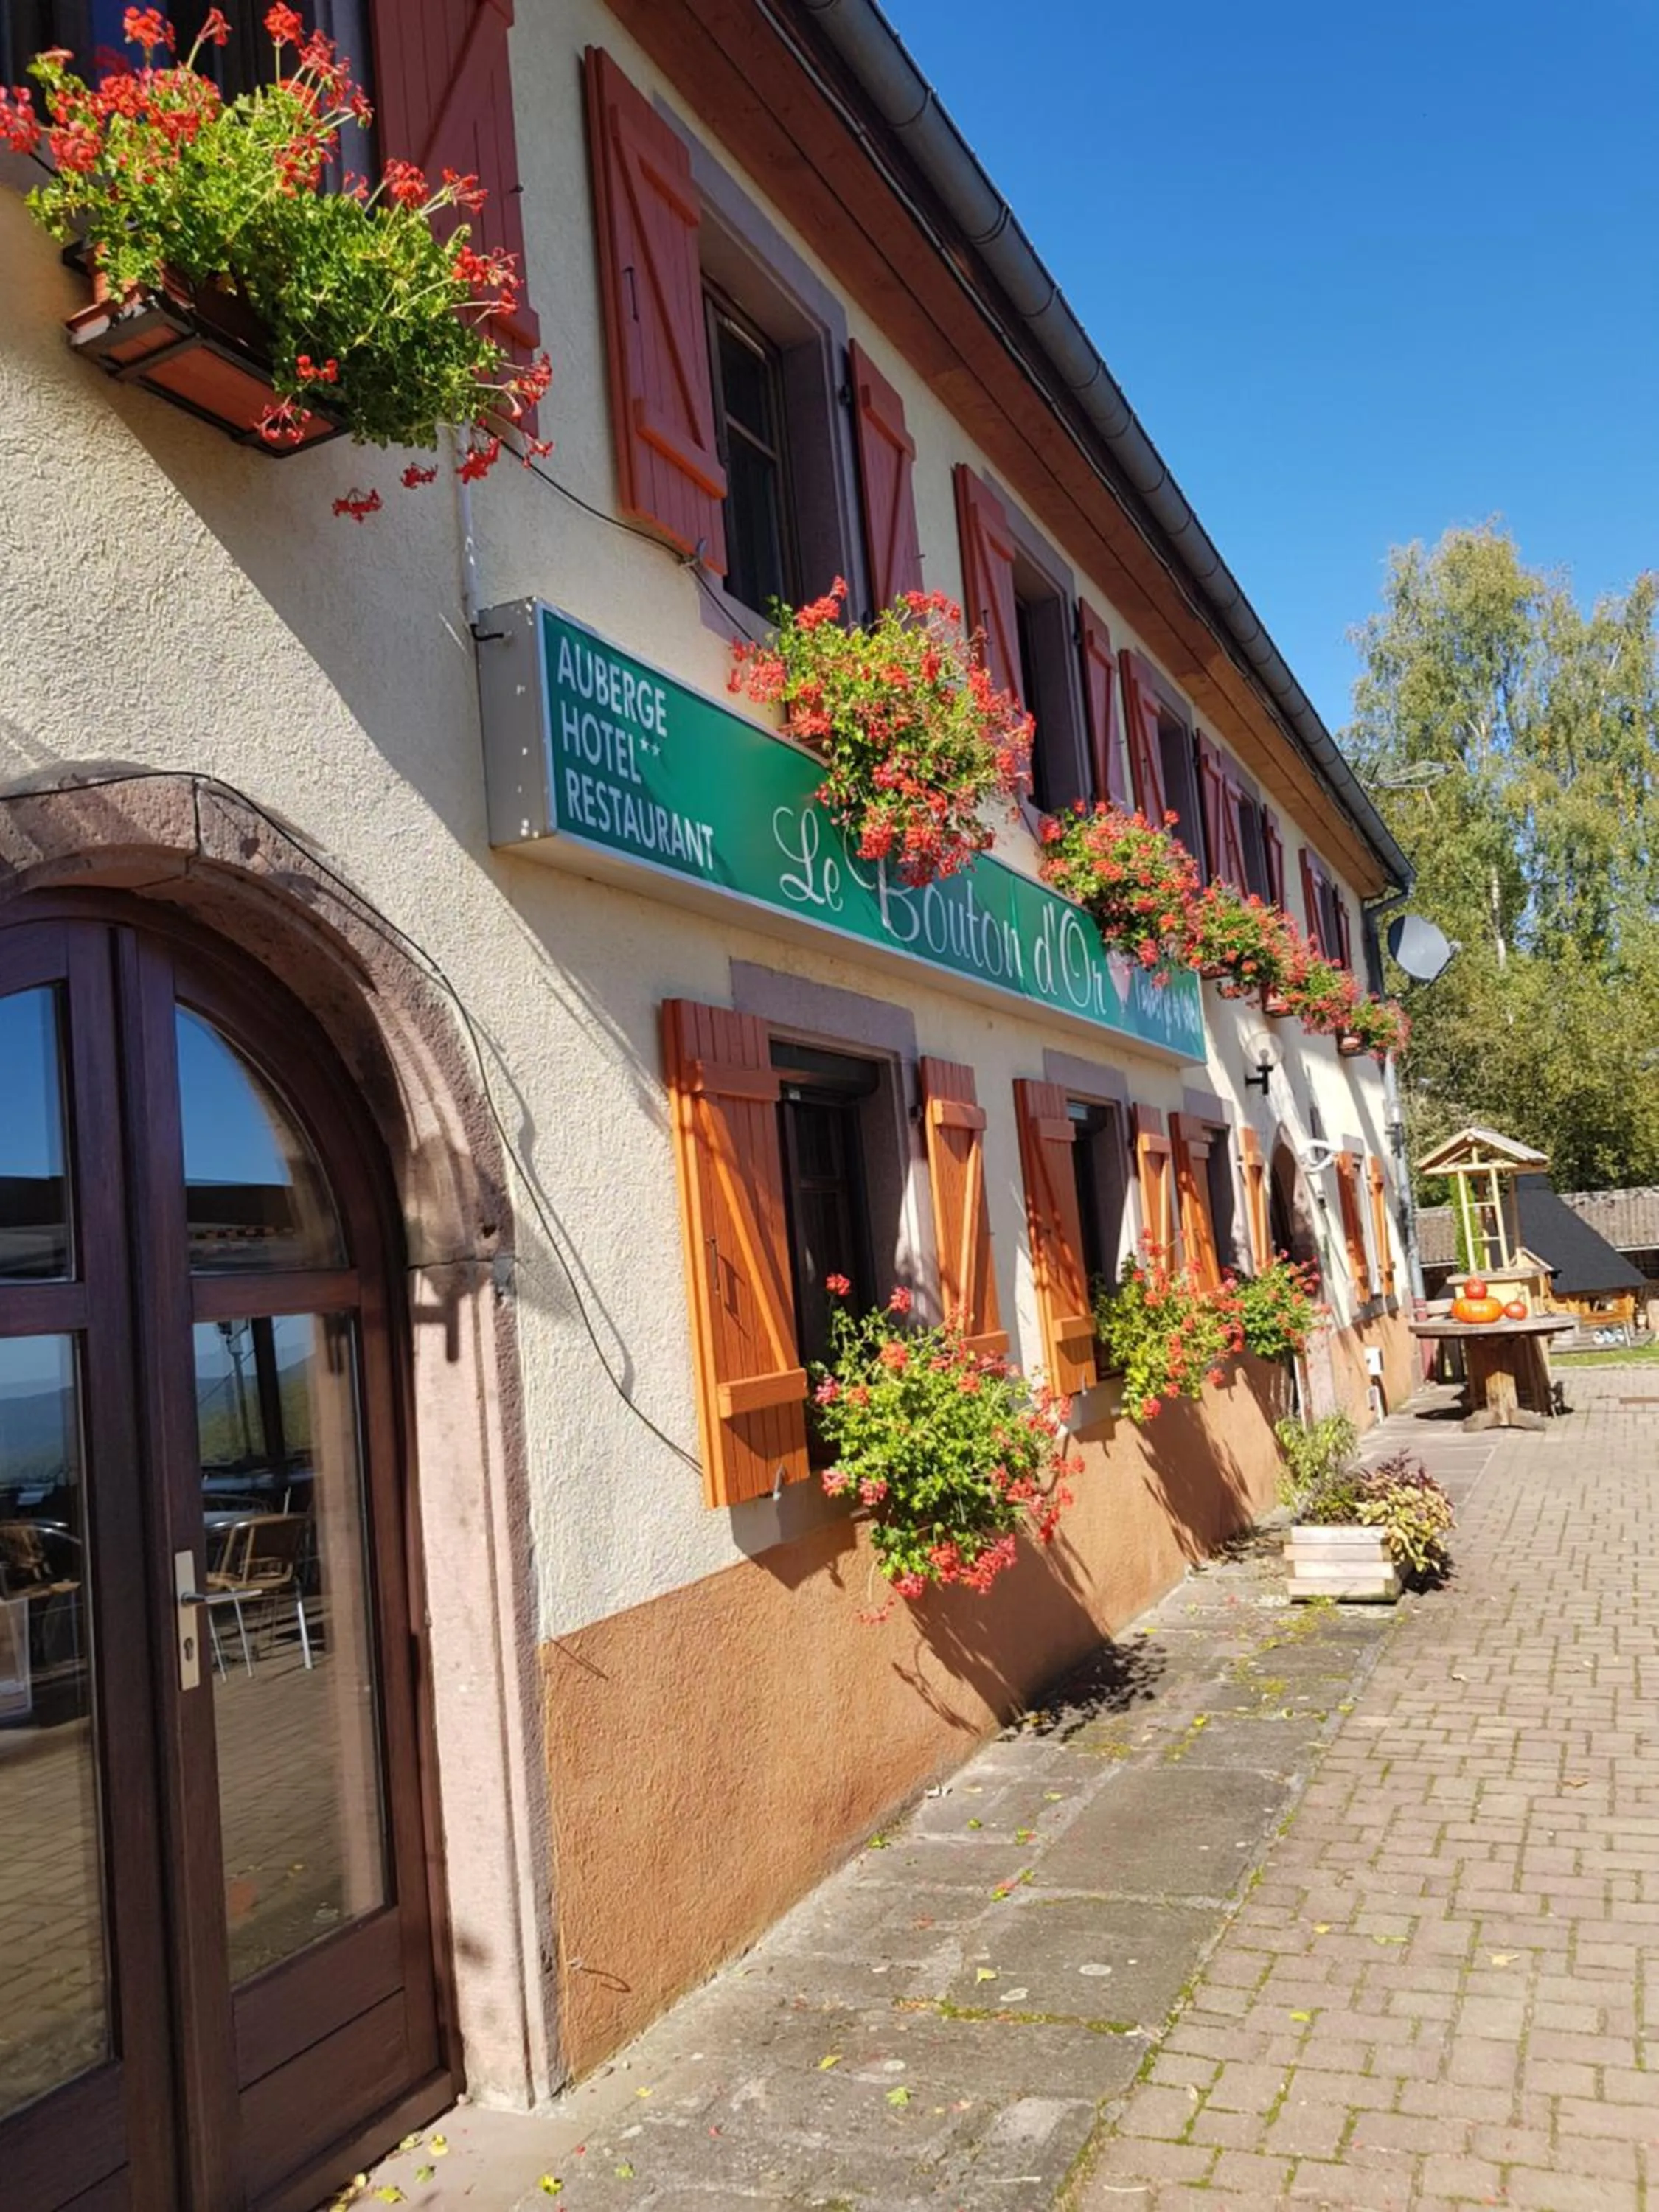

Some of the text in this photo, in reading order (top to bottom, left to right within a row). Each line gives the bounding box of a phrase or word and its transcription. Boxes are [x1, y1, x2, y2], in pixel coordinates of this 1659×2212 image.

[558, 636, 667, 737] AUBERGE
[566, 768, 713, 871] RESTAURANT
[773, 806, 844, 911] Le
[1034, 902, 1107, 1015] d'Or
